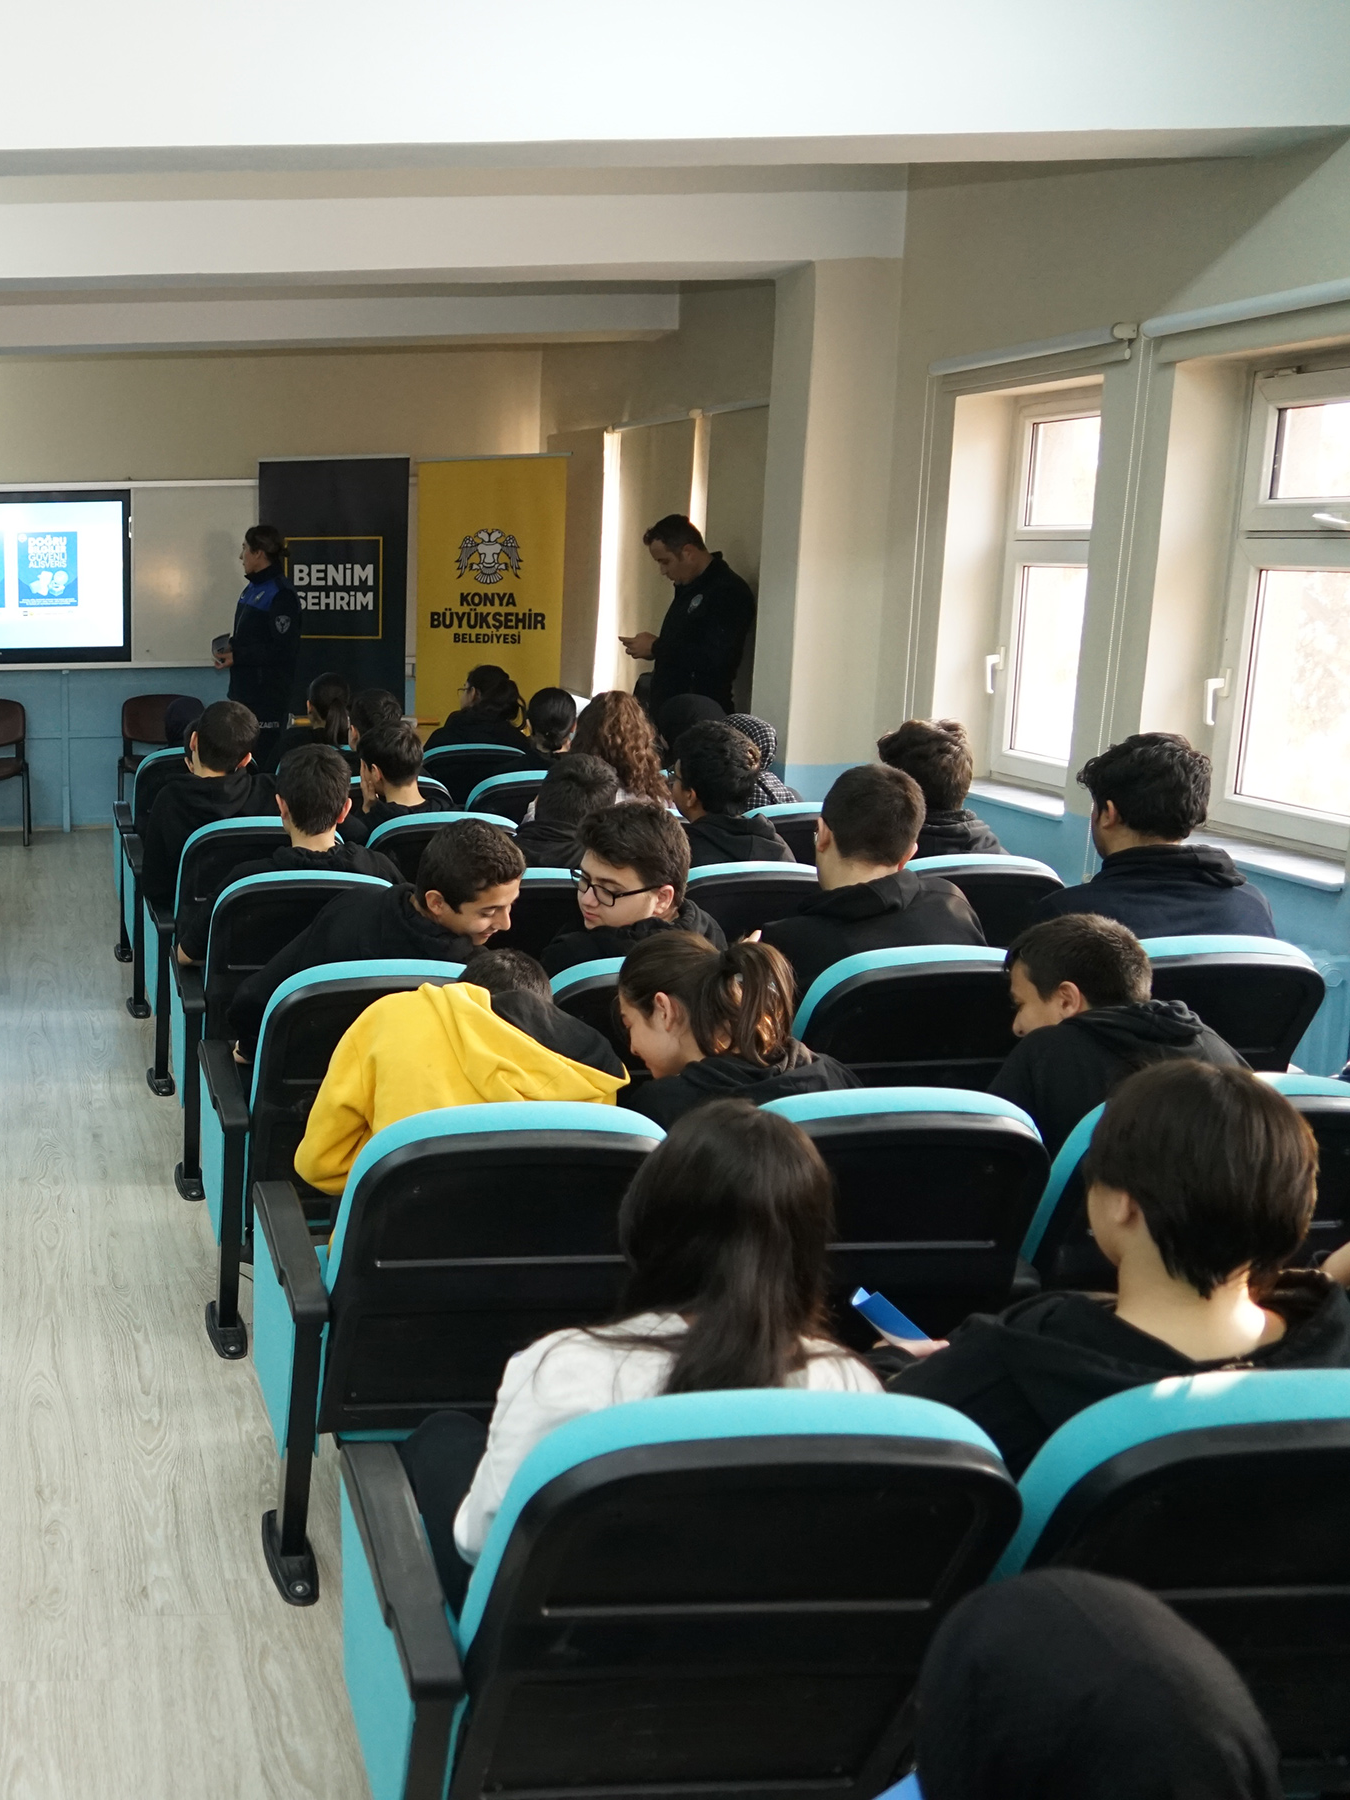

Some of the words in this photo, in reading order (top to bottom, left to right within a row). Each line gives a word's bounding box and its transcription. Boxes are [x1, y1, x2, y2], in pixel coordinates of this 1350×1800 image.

[460, 592, 517, 607] KONYA
[430, 607, 546, 632] BÜYÜKŞEHİR
[453, 630, 521, 644] BELEDİYESİ
